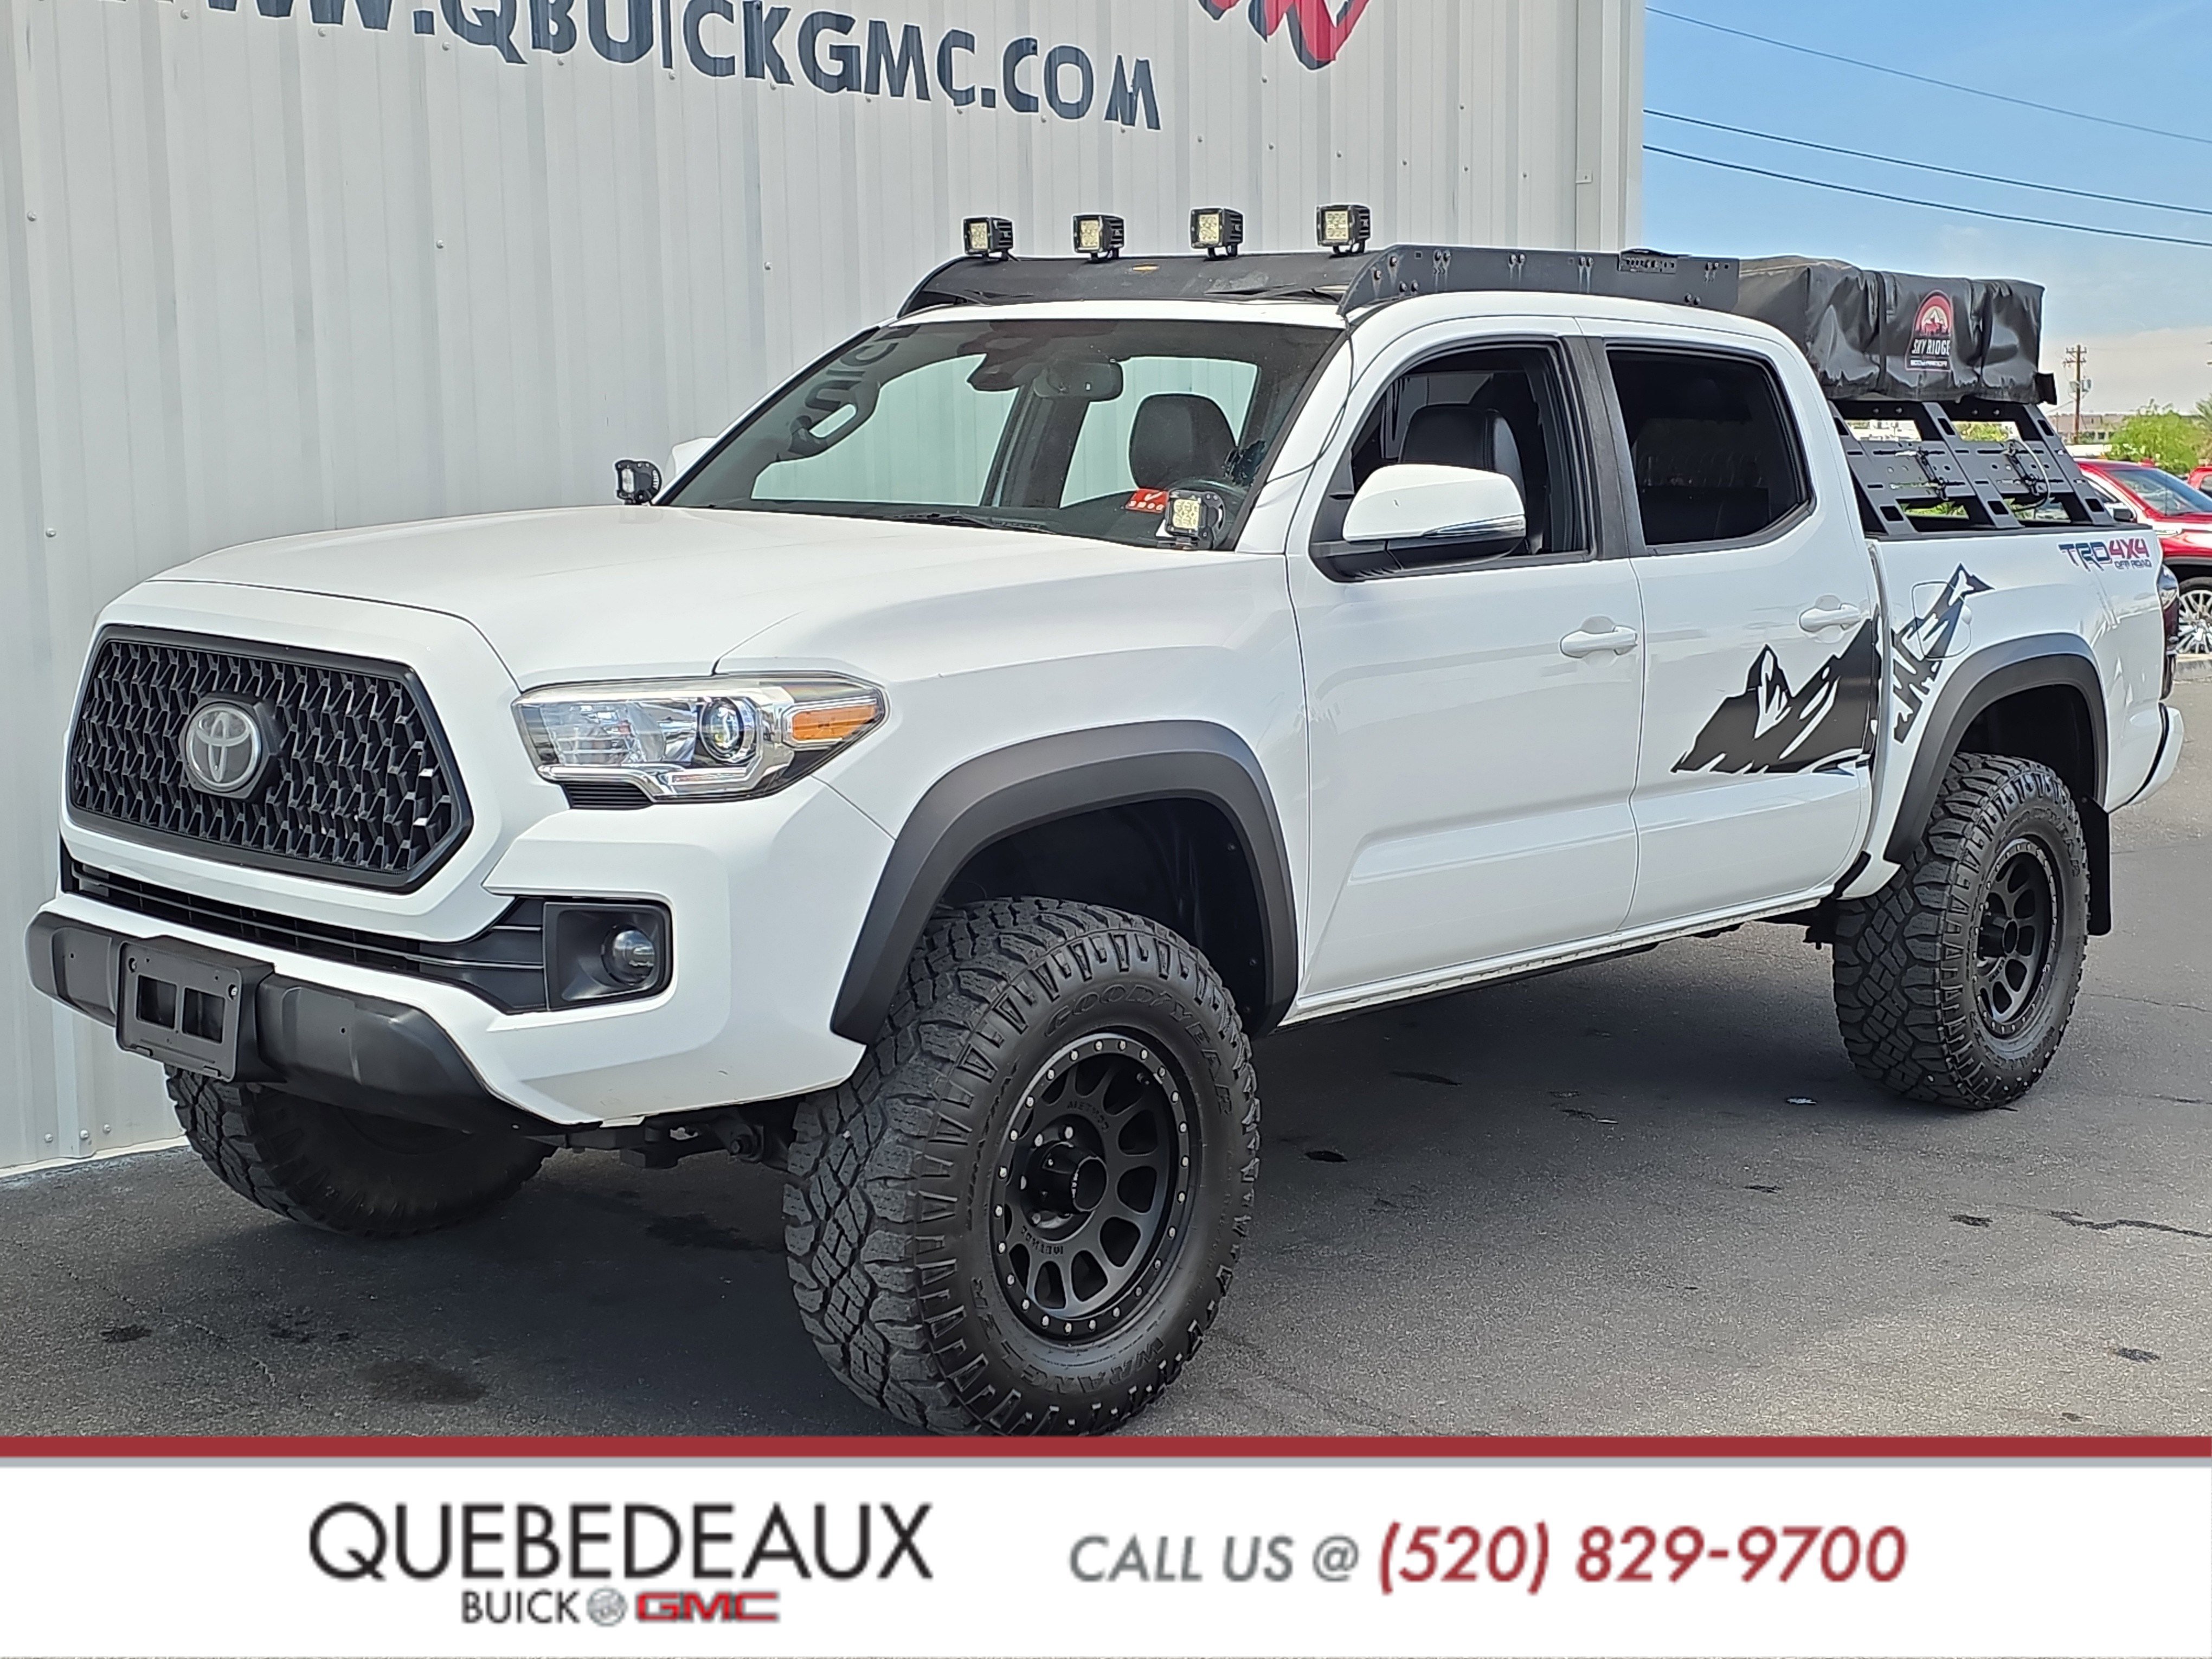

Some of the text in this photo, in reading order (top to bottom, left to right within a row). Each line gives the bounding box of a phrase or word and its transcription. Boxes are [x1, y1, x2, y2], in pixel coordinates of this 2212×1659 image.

[1911, 339, 1951, 356] SKY RIDGE
[2057, 541, 2112, 572] TRD
[2131, 560, 2152, 569] ROAD
[1044, 983, 1232, 1116] GOODYEAR
